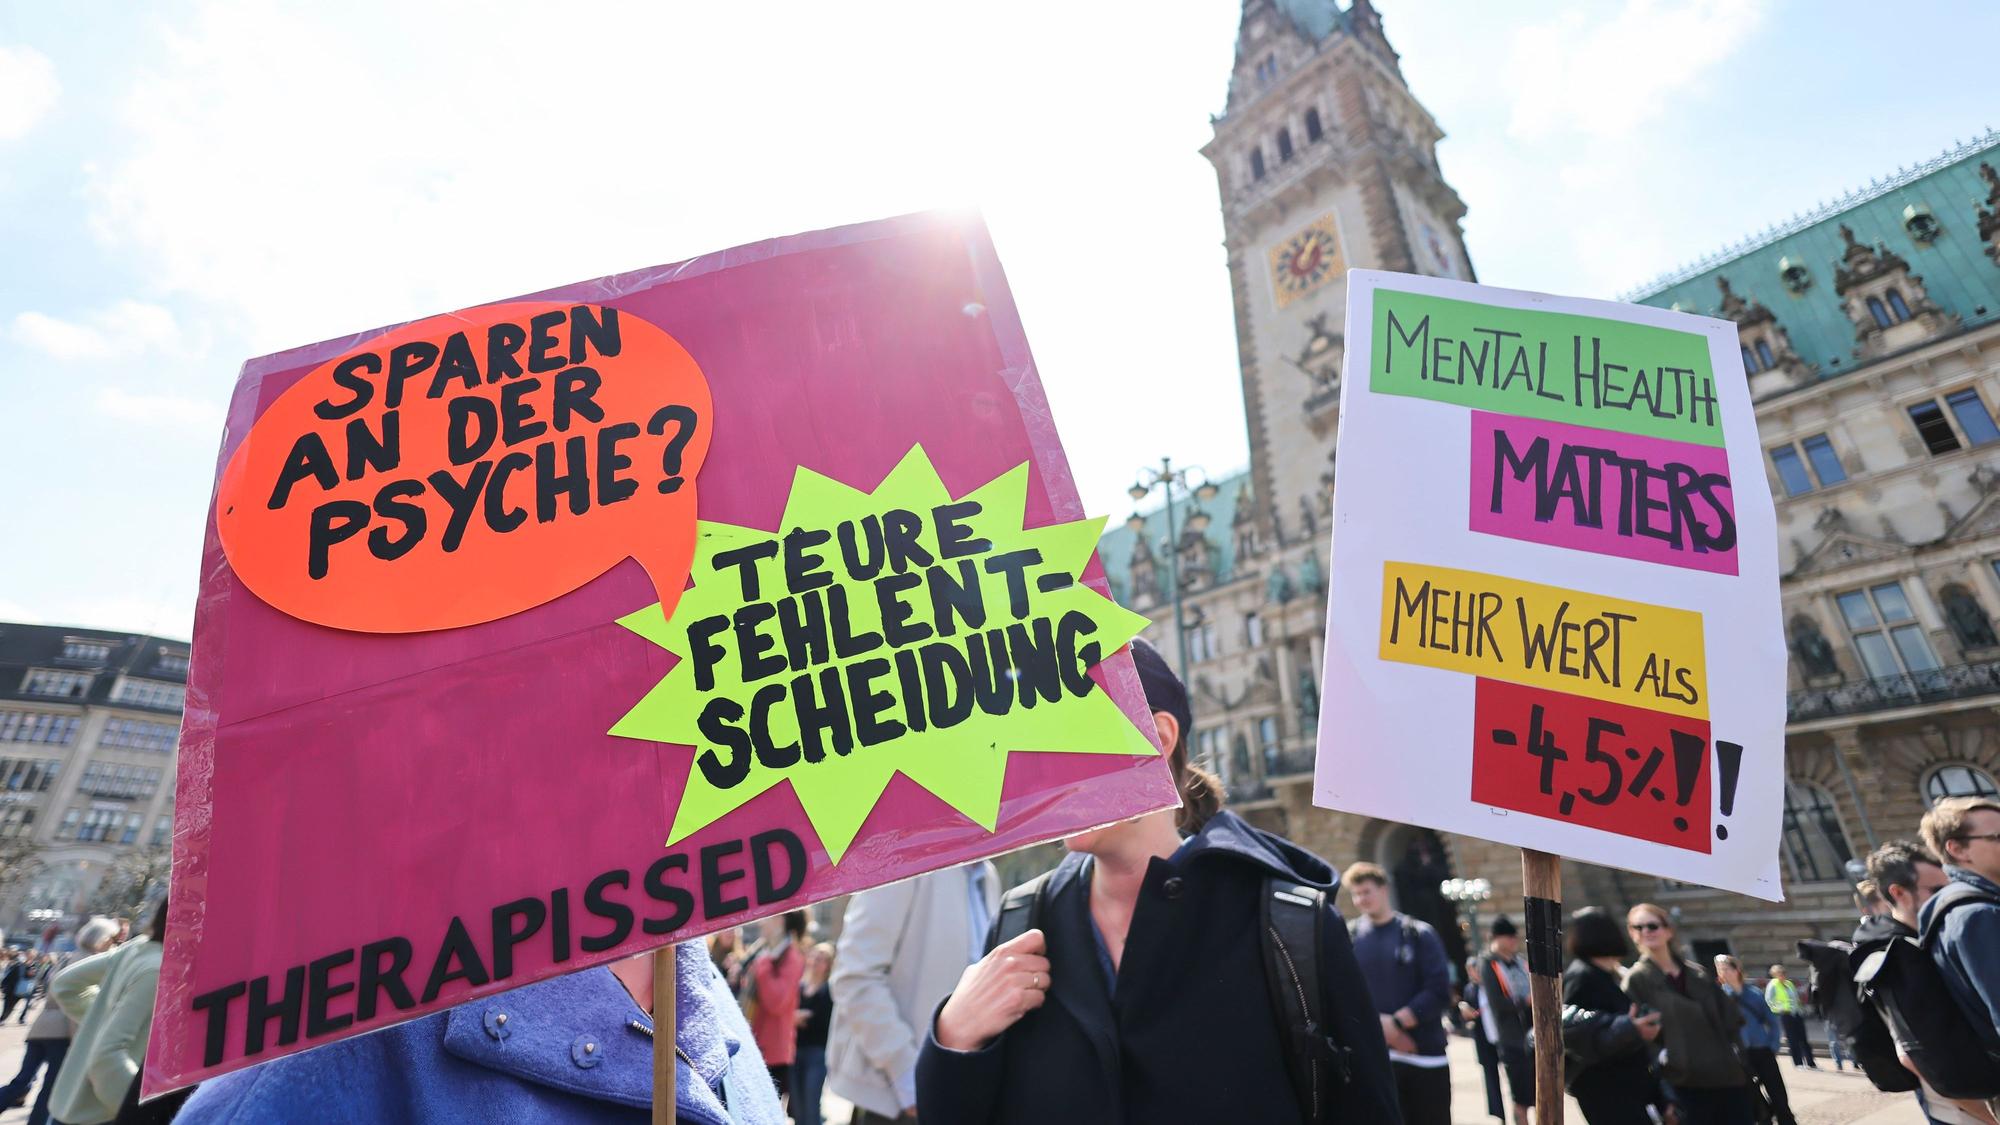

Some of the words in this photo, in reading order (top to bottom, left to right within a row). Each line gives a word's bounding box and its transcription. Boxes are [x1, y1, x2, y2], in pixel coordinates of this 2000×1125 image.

[314, 305, 622, 420] SPAREN
[268, 412, 400, 509] AN
[448, 367, 605, 466] DER
[308, 405, 698, 580] PSYCHE?
[1490, 429, 1737, 554] MATTERS
[687, 548, 1074, 692] FEHLENT-
[712, 501, 993, 602] TEURE
[697, 610, 1102, 789] SCHEIDUNG
[1390, 577, 1503, 662] MEHR
[1516, 597, 1637, 687] WERT
[1634, 653, 1699, 704] ALS
[193, 829, 808, 1067] THERAPISSED
